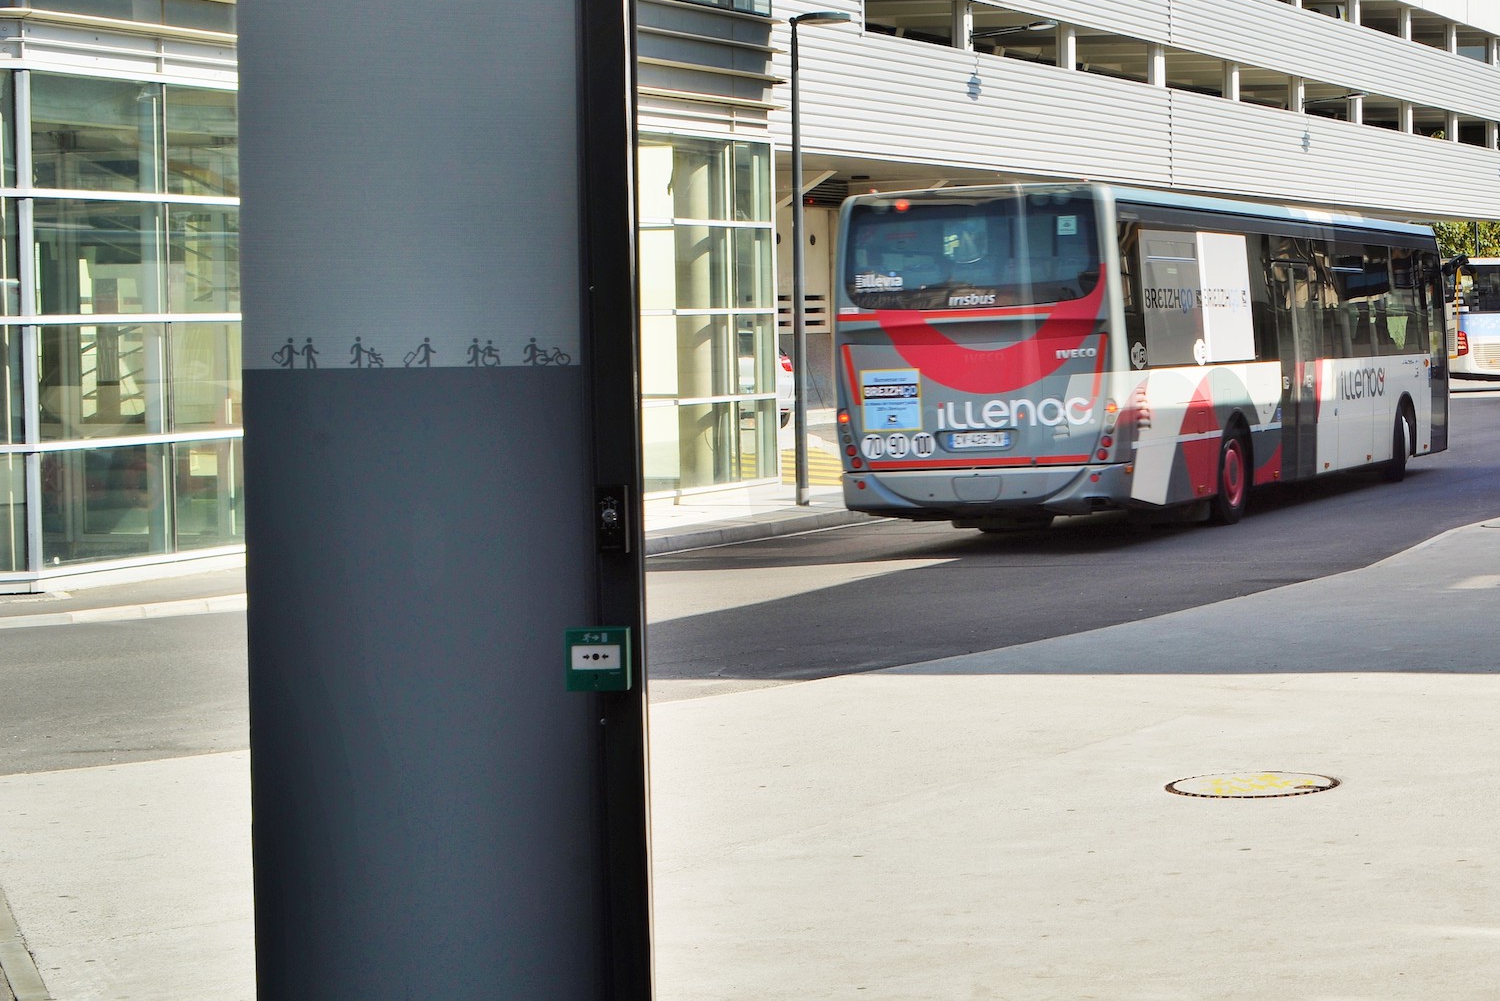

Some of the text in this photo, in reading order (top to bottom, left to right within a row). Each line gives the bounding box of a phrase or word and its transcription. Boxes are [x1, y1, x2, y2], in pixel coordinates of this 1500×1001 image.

[1055, 348, 1097, 360] IVECO
[867, 437, 882, 456] 70
[891, 436, 905, 455] 90
